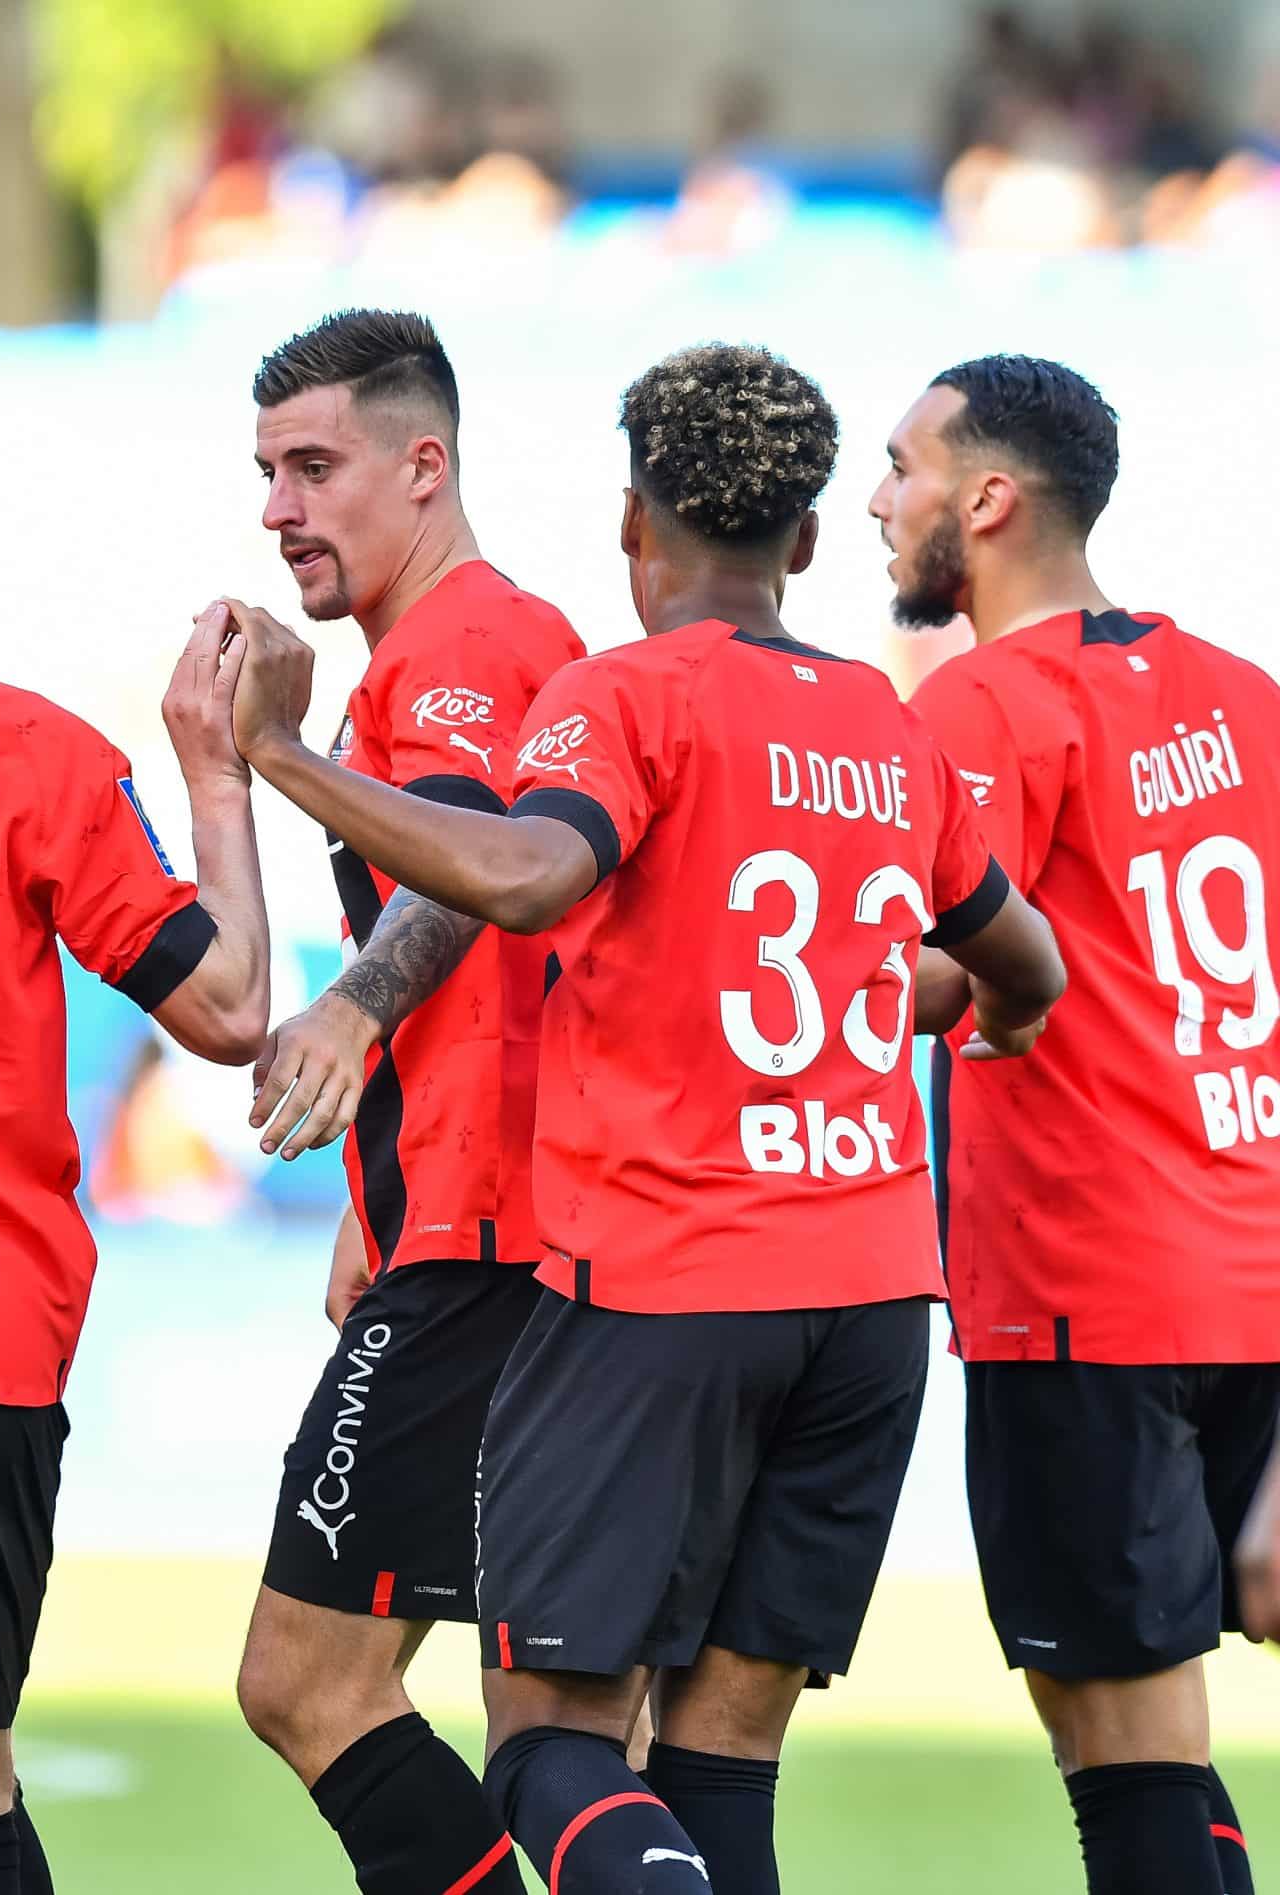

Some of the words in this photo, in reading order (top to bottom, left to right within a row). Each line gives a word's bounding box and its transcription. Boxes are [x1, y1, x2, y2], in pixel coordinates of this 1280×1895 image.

[410, 687, 496, 728] Rose
[453, 687, 495, 707] GROUPE
[515, 722, 592, 772] Rose
[719, 849, 934, 1077] 33
[1126, 835, 1280, 1057] 19
[739, 1100, 902, 1179] Blot
[313, 1323, 392, 1510] Convivio
